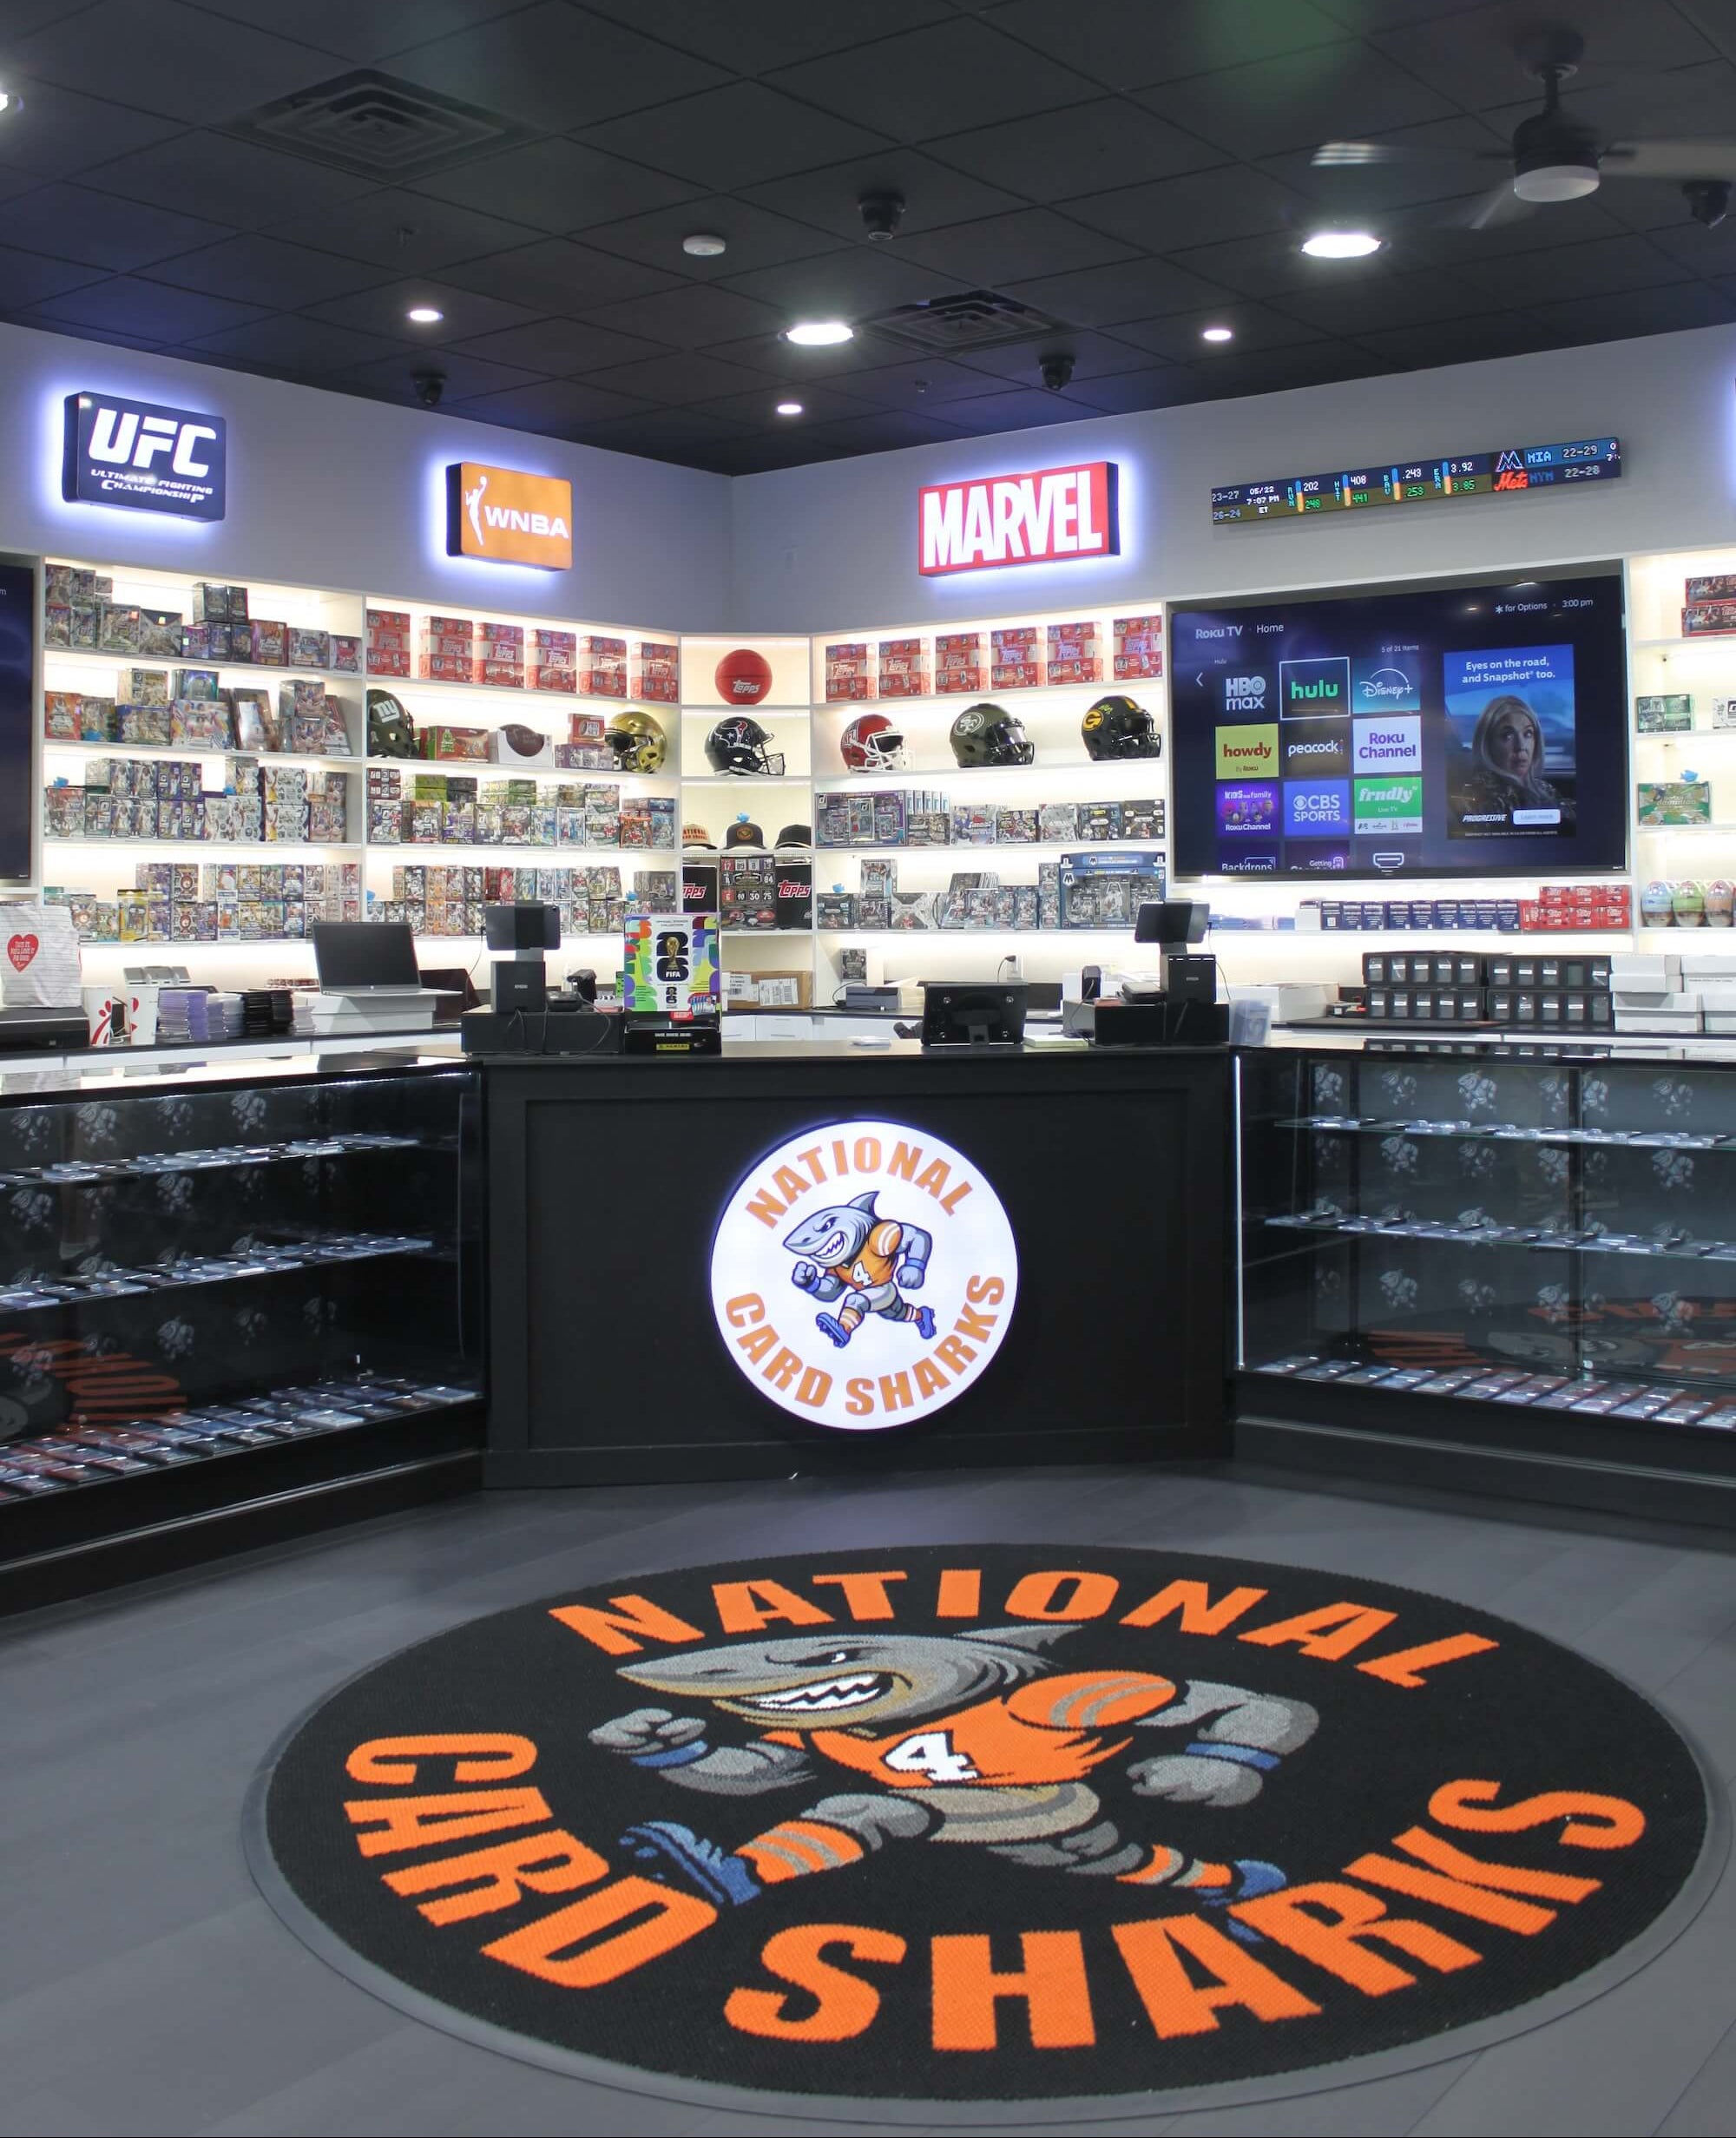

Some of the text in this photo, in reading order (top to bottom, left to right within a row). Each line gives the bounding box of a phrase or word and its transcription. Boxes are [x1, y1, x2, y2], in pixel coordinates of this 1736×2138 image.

[89, 408, 216, 477] UFC
[1528, 451, 1552, 464] MIA
[1562, 445, 1597, 458] 22-29
[1402, 468, 1422, 479] .243
[1450, 462, 1473, 473] 3.92
[1529, 465, 1600, 484] NYM 22-28
[91, 469, 214, 495] ULTIMATE FIGHTING
[1304, 481, 1319, 492] 202
[1350, 475, 1366, 485] 408
[1493, 471, 1528, 492] Mets
[101, 479, 205, 503] CHAMPIONSHIP
[1212, 490, 1240, 502] 23-27
[1249, 486, 1274, 495] 05/22
[1404, 487, 1424, 497] .253
[1246, 497, 1266, 505] 7:07
[1352, 493, 1368, 503] 441
[484, 505, 569, 539] WNBA
[924, 470, 1102, 569] MARVEL
[1213, 510, 1240, 520] 26-24
[1517, 602, 1548, 613] Options
[1580, 600, 1594, 609] pm
[1195, 626, 1243, 640] Roku TV
[1257, 623, 1285, 634] Home
[1466, 656, 1549, 673] Eyes on the road,
[1462, 673, 1482, 683] and
[1536, 670, 1556, 679] too.
[733, 680, 761, 694] Topps
[1225, 676, 1266, 697] HBO
[1291, 679, 1338, 699] hulu
[1226, 696, 1265, 710] max
[1369, 733, 1405, 745] Roku
[1223, 740, 1272, 759] howdy
[1288, 740, 1339, 757] peacock
[1359, 744, 1417, 759] Channel
[1250, 791, 1272, 799] family
[1358, 786, 1413, 803] frndly
[1307, 795, 1340, 810] CBS
[1293, 811, 1340, 822] SPORTS
[1463, 813, 1508, 823] PROGRESSIVE
[1243, 822, 1271, 831] Channel
[1221, 858, 1272, 871] Backdrops
[745, 1136, 973, 1229] NATIONAL
[852, 1261, 872, 1286] 4
[726, 1275, 1005, 1417] CARD SHARKS
[549, 1569, 1499, 1688] NATIONAL
[883, 1732, 981, 1783] 4
[344, 1733, 1646, 2050] CARD SHARKS
